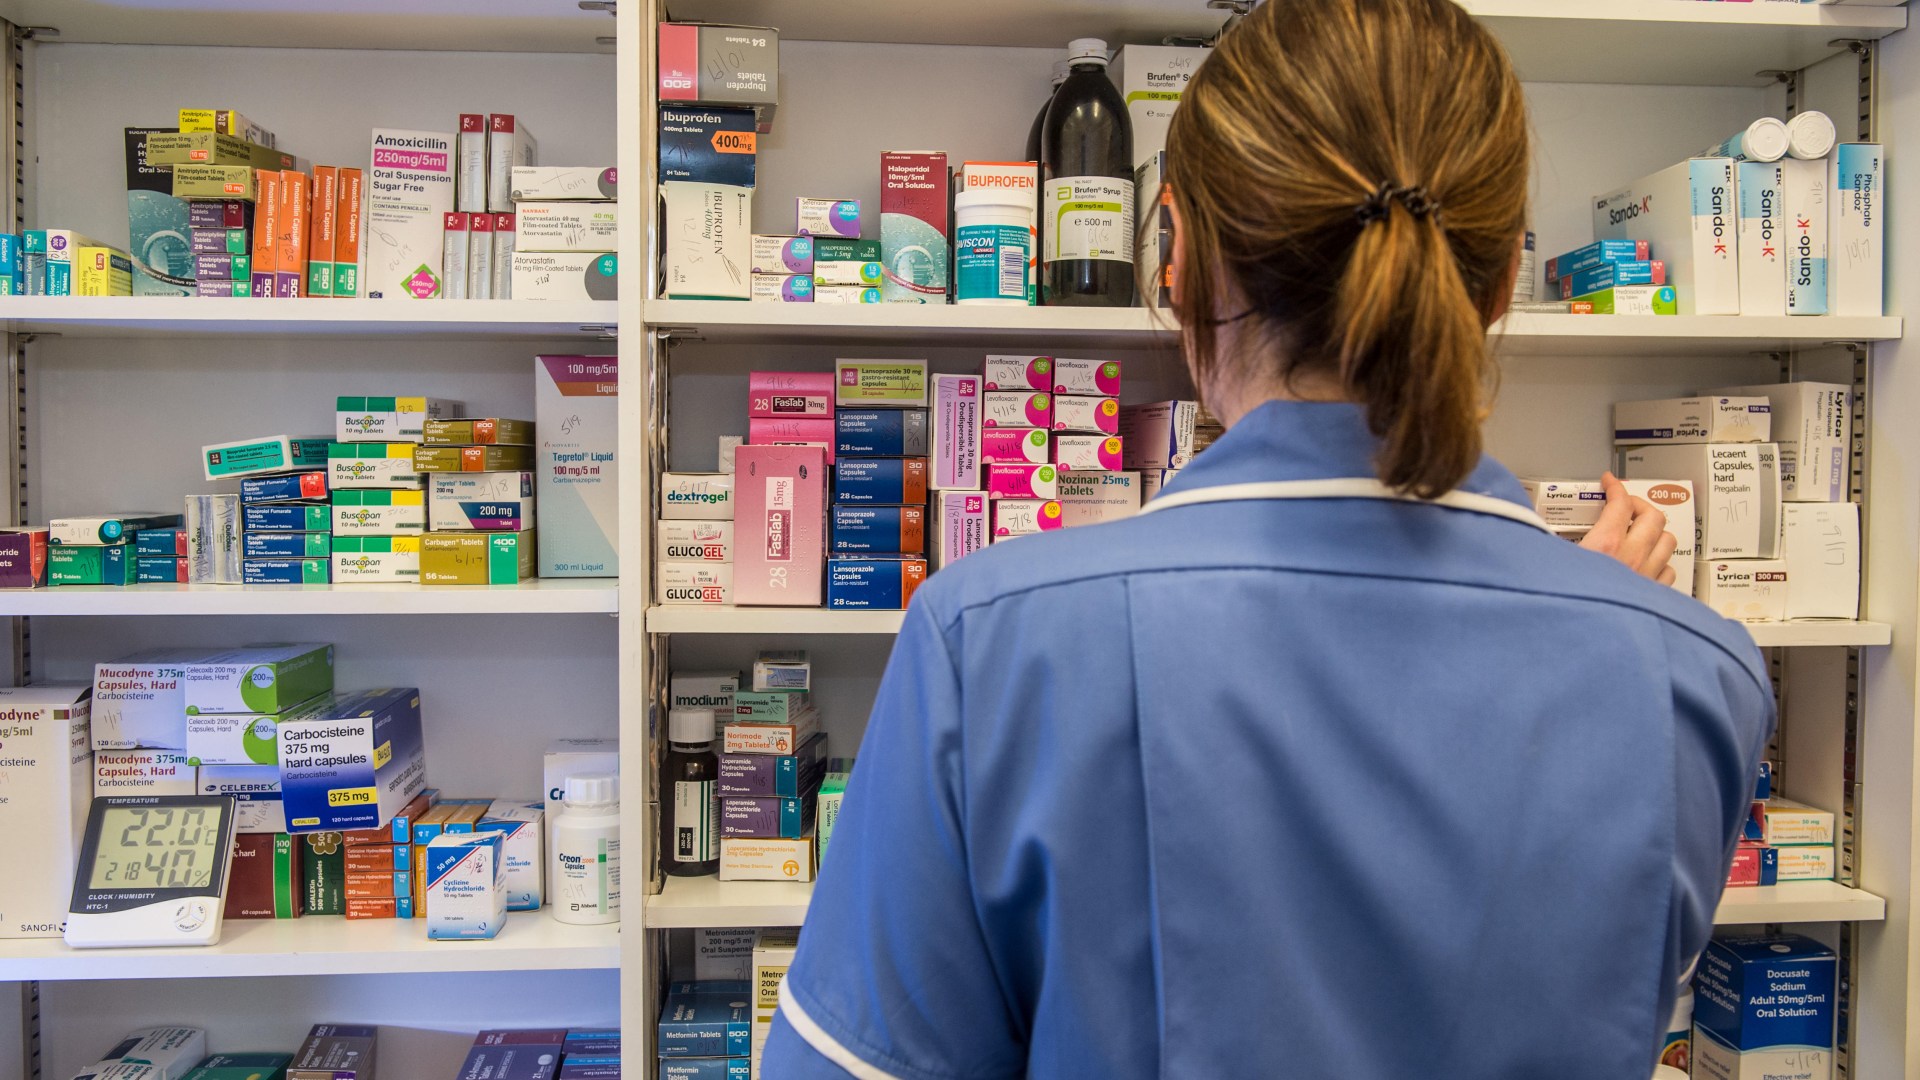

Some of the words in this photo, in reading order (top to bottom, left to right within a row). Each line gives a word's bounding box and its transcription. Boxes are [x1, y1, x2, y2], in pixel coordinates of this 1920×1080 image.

[752, 38, 766, 47] 84
[663, 80, 692, 89] 200
[726, 81, 767, 92] Ibuprofen
[663, 111, 722, 124] Ibuprofen
[375, 134, 447, 150] Amoxicillin
[376, 151, 445, 167] 250mg/5ml
[177, 168, 208, 176] Amitriptyline
[887, 165, 930, 174] Haloperidol
[373, 170, 394, 179] Oral
[396, 170, 452, 183] Suspension
[967, 175, 1034, 188] IBUPROFEN
[373, 181, 401, 193] Sugar
[403, 183, 425, 192] Free
[1103, 188, 1121, 196] Syrup
[325, 175, 333, 211] Amoxicillin
[350, 177, 359, 213] Amoxicillin
[267, 181, 276, 217] Amoxicillin
[1863, 173, 1873, 227] Phosphate
[323, 212, 331, 241] Capsules
[713, 191, 723, 255] IBUPROFEN
[1084, 218, 1100, 226] 500
[1101, 218, 1112, 226] ml
[266, 217, 274, 247] Capsules
[349, 214, 357, 243] Capsules
[411, 280, 434, 289] 250mg/
[987, 358, 1020, 366] Levofloxacin
[1056, 361, 1089, 369] Levofloxacin
[567, 364, 584, 374] 100
[586, 364, 618, 375] mg/5m
[861, 380, 887, 388] capsules
[754, 399, 769, 410] 28
[774, 397, 804, 407] FasTab
[807, 400, 825, 409] 30mg
[345, 417, 385, 427] Buscopan
[839, 413, 878, 421] Lansoprazole
[958, 402, 966, 449] Orodispersible
[591, 452, 614, 462] Liquid
[1712, 449, 1747, 458] Lecaent
[1759, 454, 1774, 462] 300
[1832, 451, 1842, 465] 50
[336, 463, 376, 473] Buscopan
[552, 465, 567, 475] 100
[568, 465, 588, 476] mg/5
[1058, 474, 1099, 485] Nozinan
[1101, 475, 1130, 487] 25mg
[1714, 473, 1735, 482] hard
[1831, 467, 1841, 486] mg
[774, 480, 787, 507] 15mg
[1058, 486, 1094, 496] Tablets
[1714, 485, 1751, 493] Pregabalin
[667, 490, 728, 504] dextrogel
[1651, 489, 1670, 499] 200
[1671, 490, 1687, 501] mg
[1060, 498, 1105, 506] evomepromazine
[480, 506, 497, 515] 200
[341, 511, 381, 522] Buscopan
[768, 512, 783, 557] FasTab
[493, 538, 516, 546] 400
[341, 558, 381, 568] Buscopan
[833, 565, 874, 573] Lansoprazole
[769, 566, 787, 589] 28
[833, 572, 861, 580] Capsules
[99, 668, 154, 679] Mucodyne
[157, 668, 185, 678] 375m
[186, 666, 214, 674] Celecoxib
[98, 680, 147, 691] Capsules,
[150, 680, 177, 690] Hard
[97, 692, 154, 700] Carbocisteine
[284, 726, 365, 741] Carbocisteine
[727, 732, 762, 740] Norimode
[285, 743, 308, 755] 375
[310, 744, 330, 754] mg
[727, 741, 742, 749] 2mg
[98, 755, 153, 766] Mucodyne
[285, 756, 312, 769] hard
[314, 753, 367, 768] capsules
[721, 757, 752, 765] Loperamide
[98, 767, 147, 778] Capsules,
[150, 766, 176, 776] Hard
[98, 779, 155, 787] Carbocisteine
[220, 783, 277, 792] CELEBREX
[329, 791, 350, 803] 375
[352, 791, 370, 802] mg
[725, 805, 761, 813] Hydrochloride
[120, 808, 206, 847] 22.0
[559, 853, 581, 863] Creon
[443, 879, 469, 887] Cyclizine
[443, 885, 485, 893] Hydrochloride
[21, 924, 57, 932] SANOFI
[705, 929, 756, 937] Metronidazole
[701, 946, 716, 954] Oral
[1766, 969, 1811, 979] Docusate
[1770, 982, 1806, 991] Sodium
[1749, 995, 1776, 1005] Adult
[1777, 994, 1825, 1005] 50mg/5ml
[1756, 1008, 1777, 1017] Oral
[1778, 1007, 1818, 1017] Solution
[666, 1031, 698, 1039] Metformin
[667, 1066, 699, 1074] Metformin
